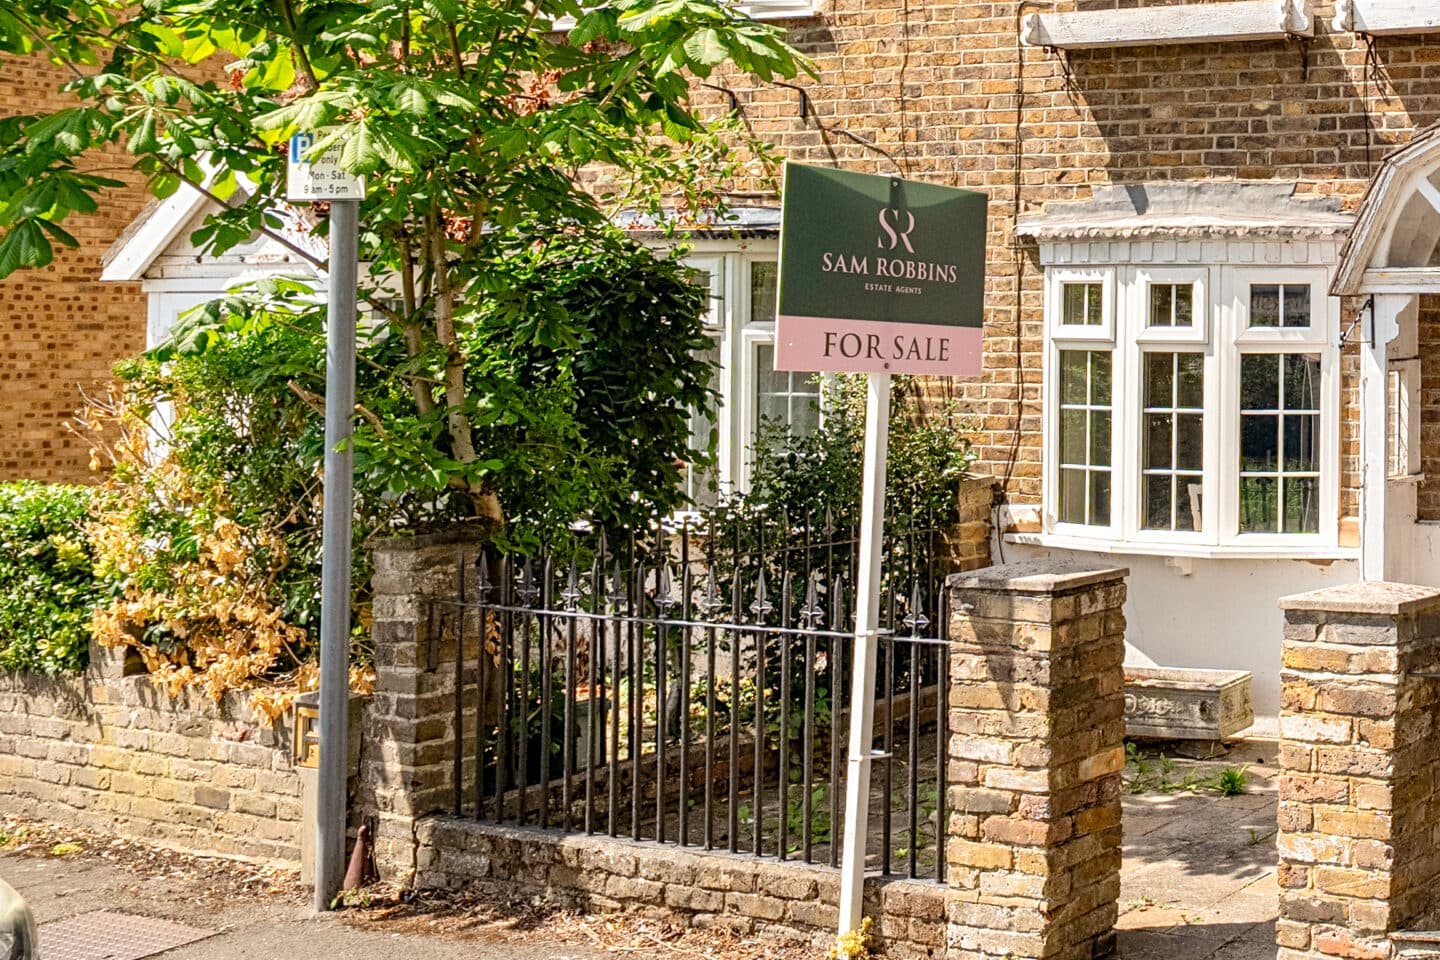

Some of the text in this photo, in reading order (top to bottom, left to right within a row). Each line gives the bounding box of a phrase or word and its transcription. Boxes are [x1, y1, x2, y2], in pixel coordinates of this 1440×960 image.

[297, 136, 311, 161] P
[320, 155, 338, 166] only
[331, 170, 346, 180] Sat
[822, 252, 957, 283] SAM ROBBINS
[864, 282, 922, 295] ESTATE AGENTS
[822, 331, 950, 362] FOR SALE
